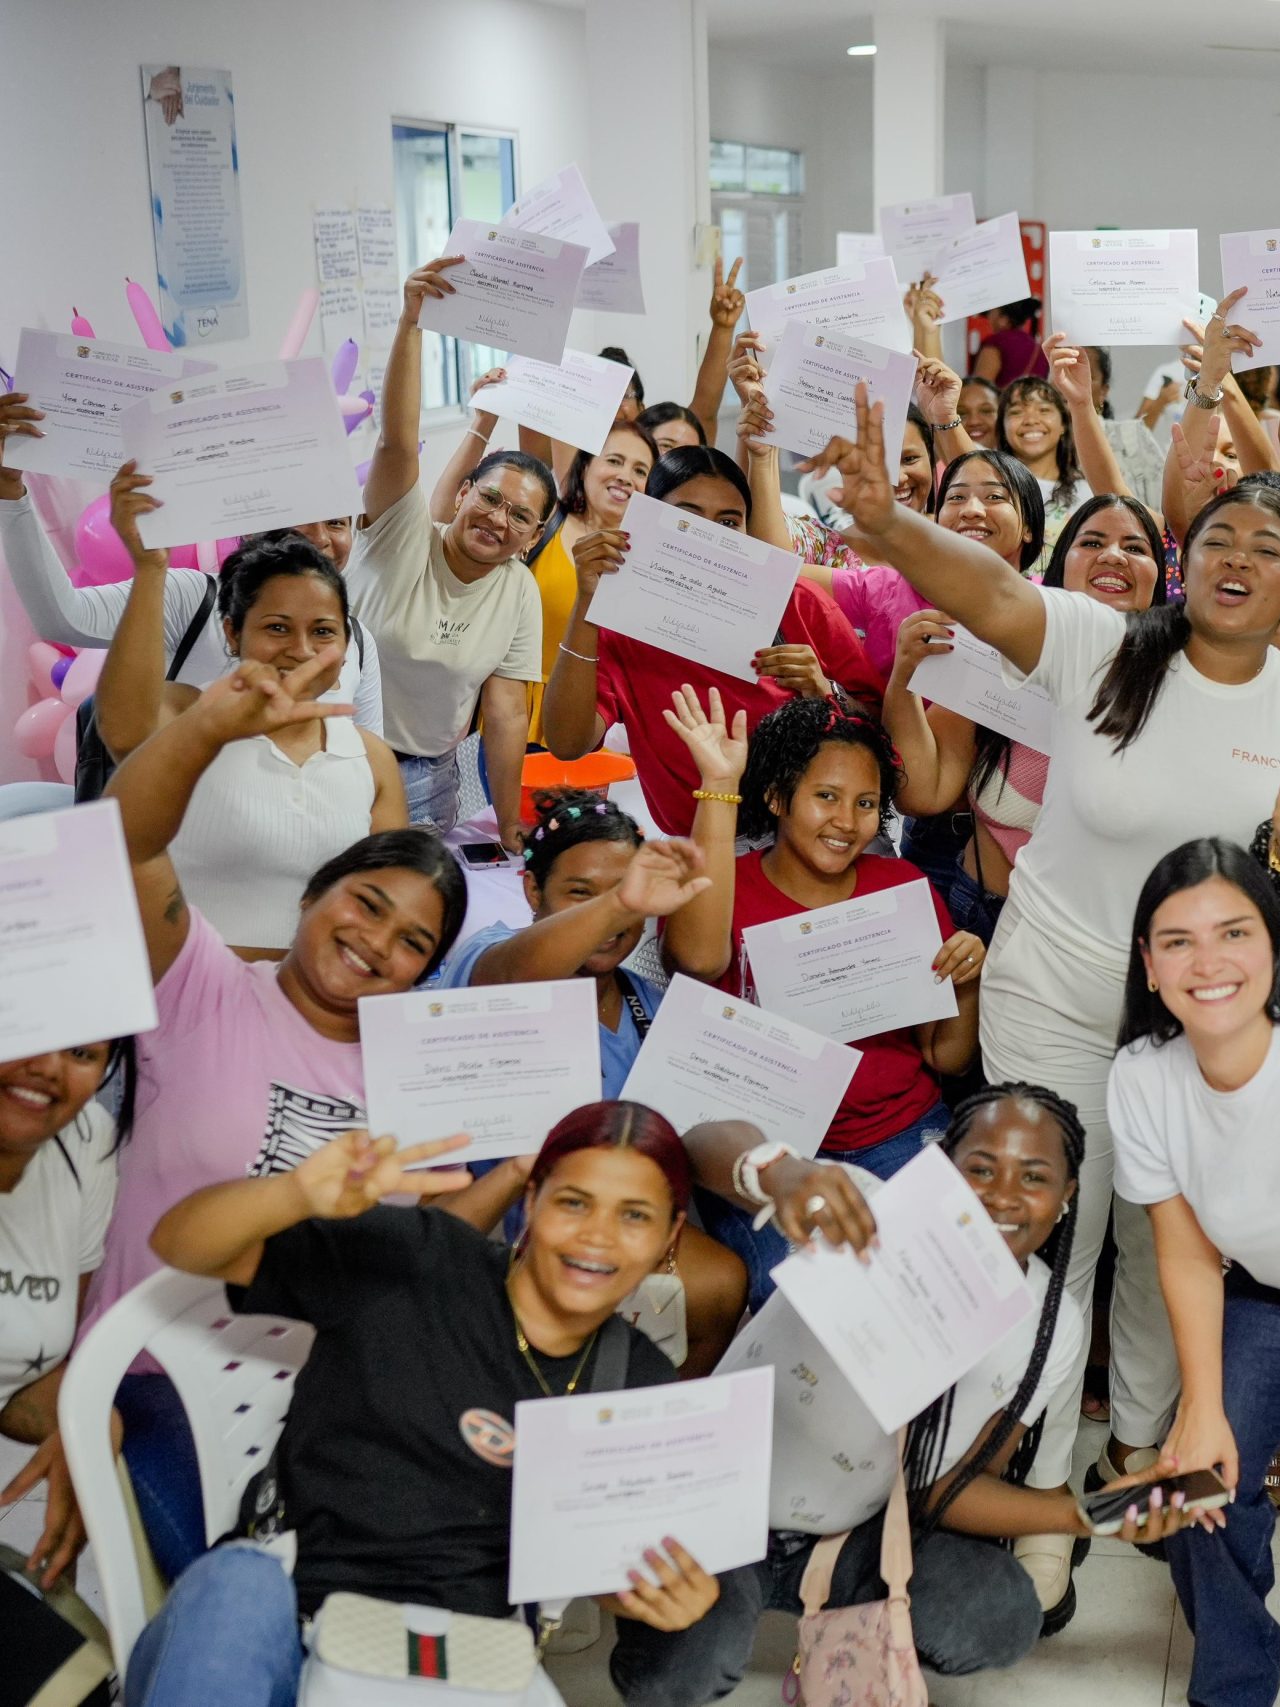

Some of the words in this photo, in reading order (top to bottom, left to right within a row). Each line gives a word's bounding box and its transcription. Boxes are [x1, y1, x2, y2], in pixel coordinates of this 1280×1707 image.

[473, 249, 507, 263] CERTIFICADO
[514, 260, 546, 272] ASISTENCIA
[783, 299, 820, 312] CERTIFICADO
[828, 290, 860, 302] ASISTENCIA
[197, 317, 218, 328] TENA
[800, 357, 835, 373] CERTIFICADO
[833, 368, 842, 376] DE
[64, 370, 112, 386] CERTIFICADO
[113, 379, 125, 388] DE
[125, 382, 159, 394] ASISTEN
[661, 540, 703, 561] CERTIFICADO
[701, 556, 712, 565] DE
[711, 560, 749, 580] ASISTENCIA
[797, 940, 843, 959] CERTIFICADO
[841, 938, 853, 947] DE
[852, 927, 892, 944] ASISTENCIA
[701, 1028, 749, 1054] CERTIFICADO
[746, 1047, 759, 1058] DE
[758, 1052, 799, 1075] ASISTENCIA
